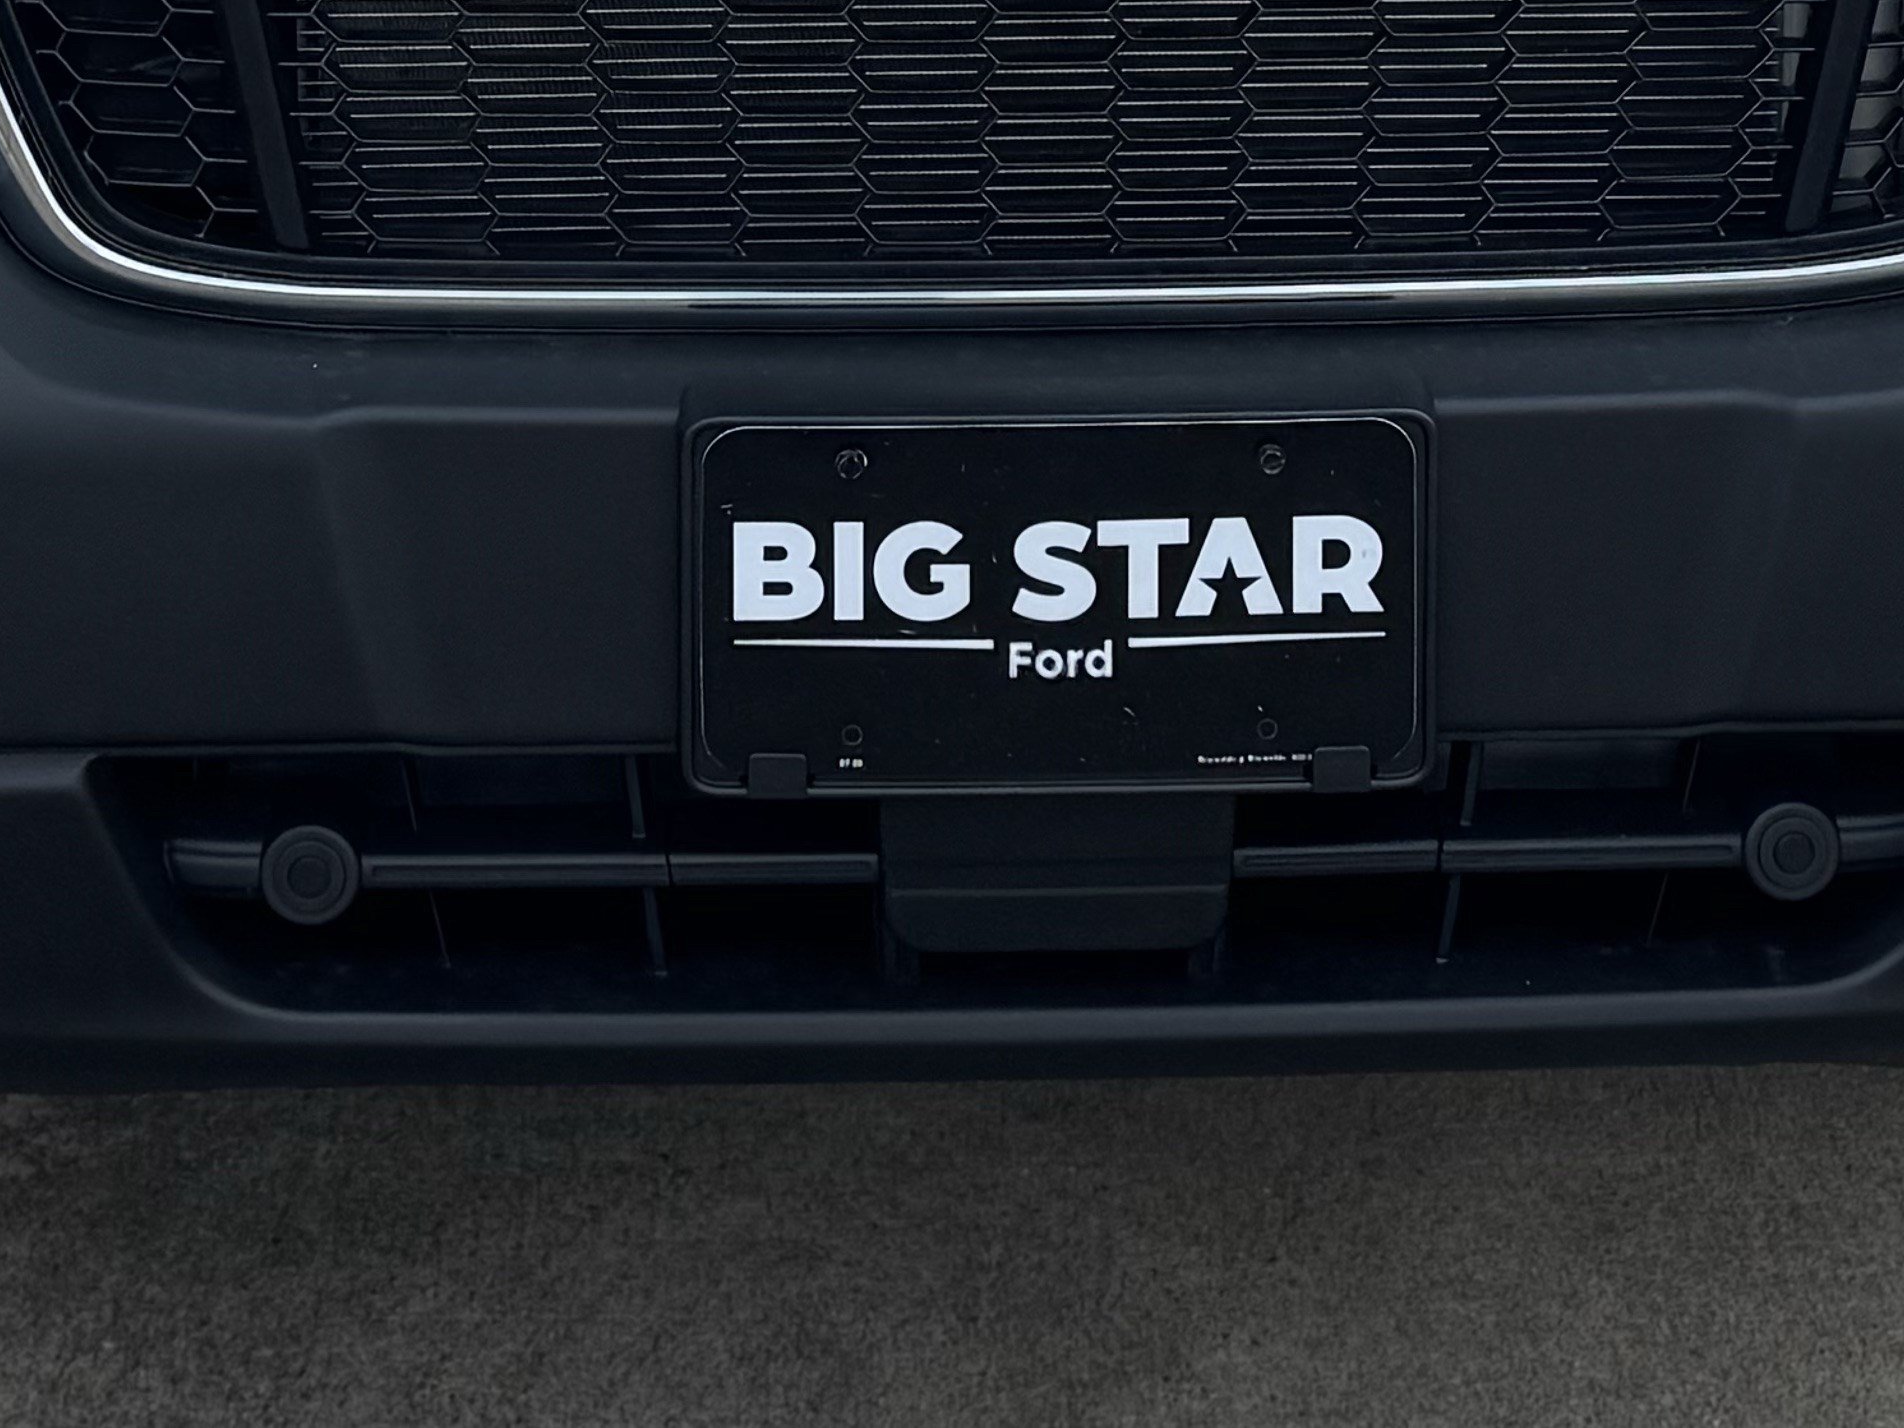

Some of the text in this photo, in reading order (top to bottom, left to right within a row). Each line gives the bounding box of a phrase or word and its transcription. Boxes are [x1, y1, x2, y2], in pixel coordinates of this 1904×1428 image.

[733, 514, 1386, 622] BIG STAR
[1008, 638, 1114, 679] Ford
